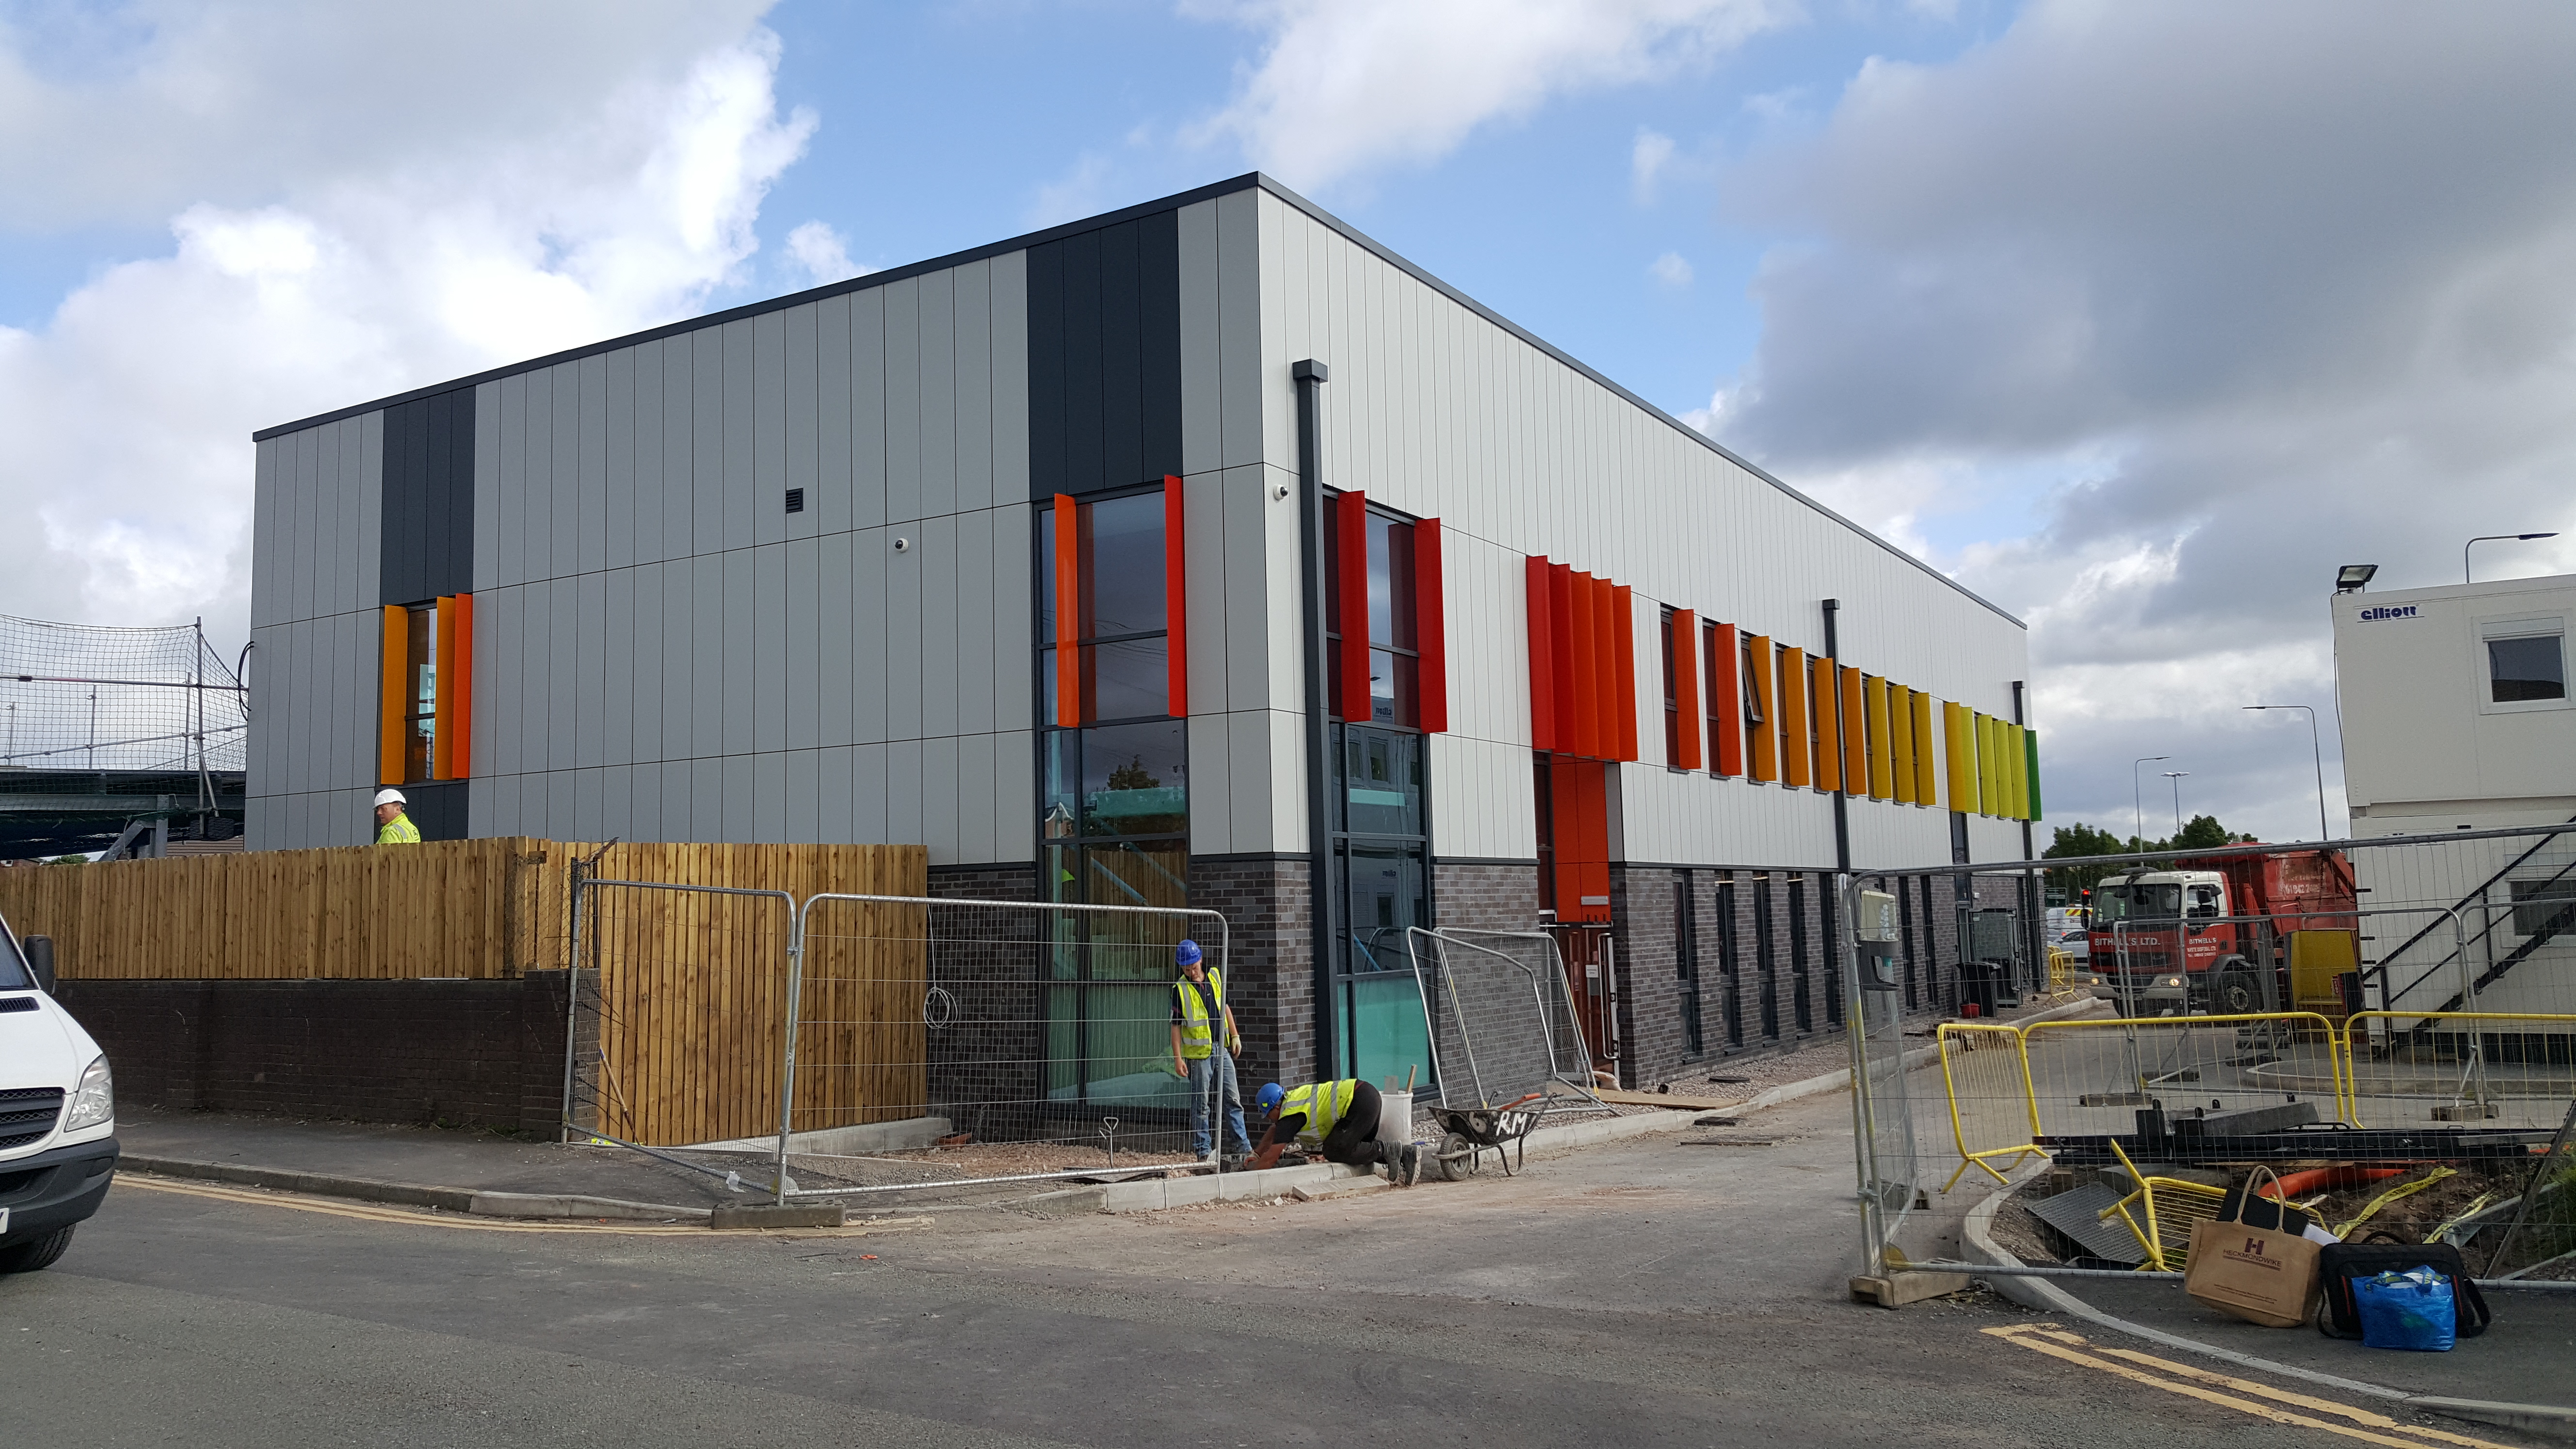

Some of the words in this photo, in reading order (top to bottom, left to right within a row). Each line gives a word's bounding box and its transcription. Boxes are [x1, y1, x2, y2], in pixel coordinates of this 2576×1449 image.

[2361, 606, 2416, 620] elliott
[2095, 937, 2137, 946] BITHL'S
[2223, 1249, 2282, 1267] HECKMONDWIKE
